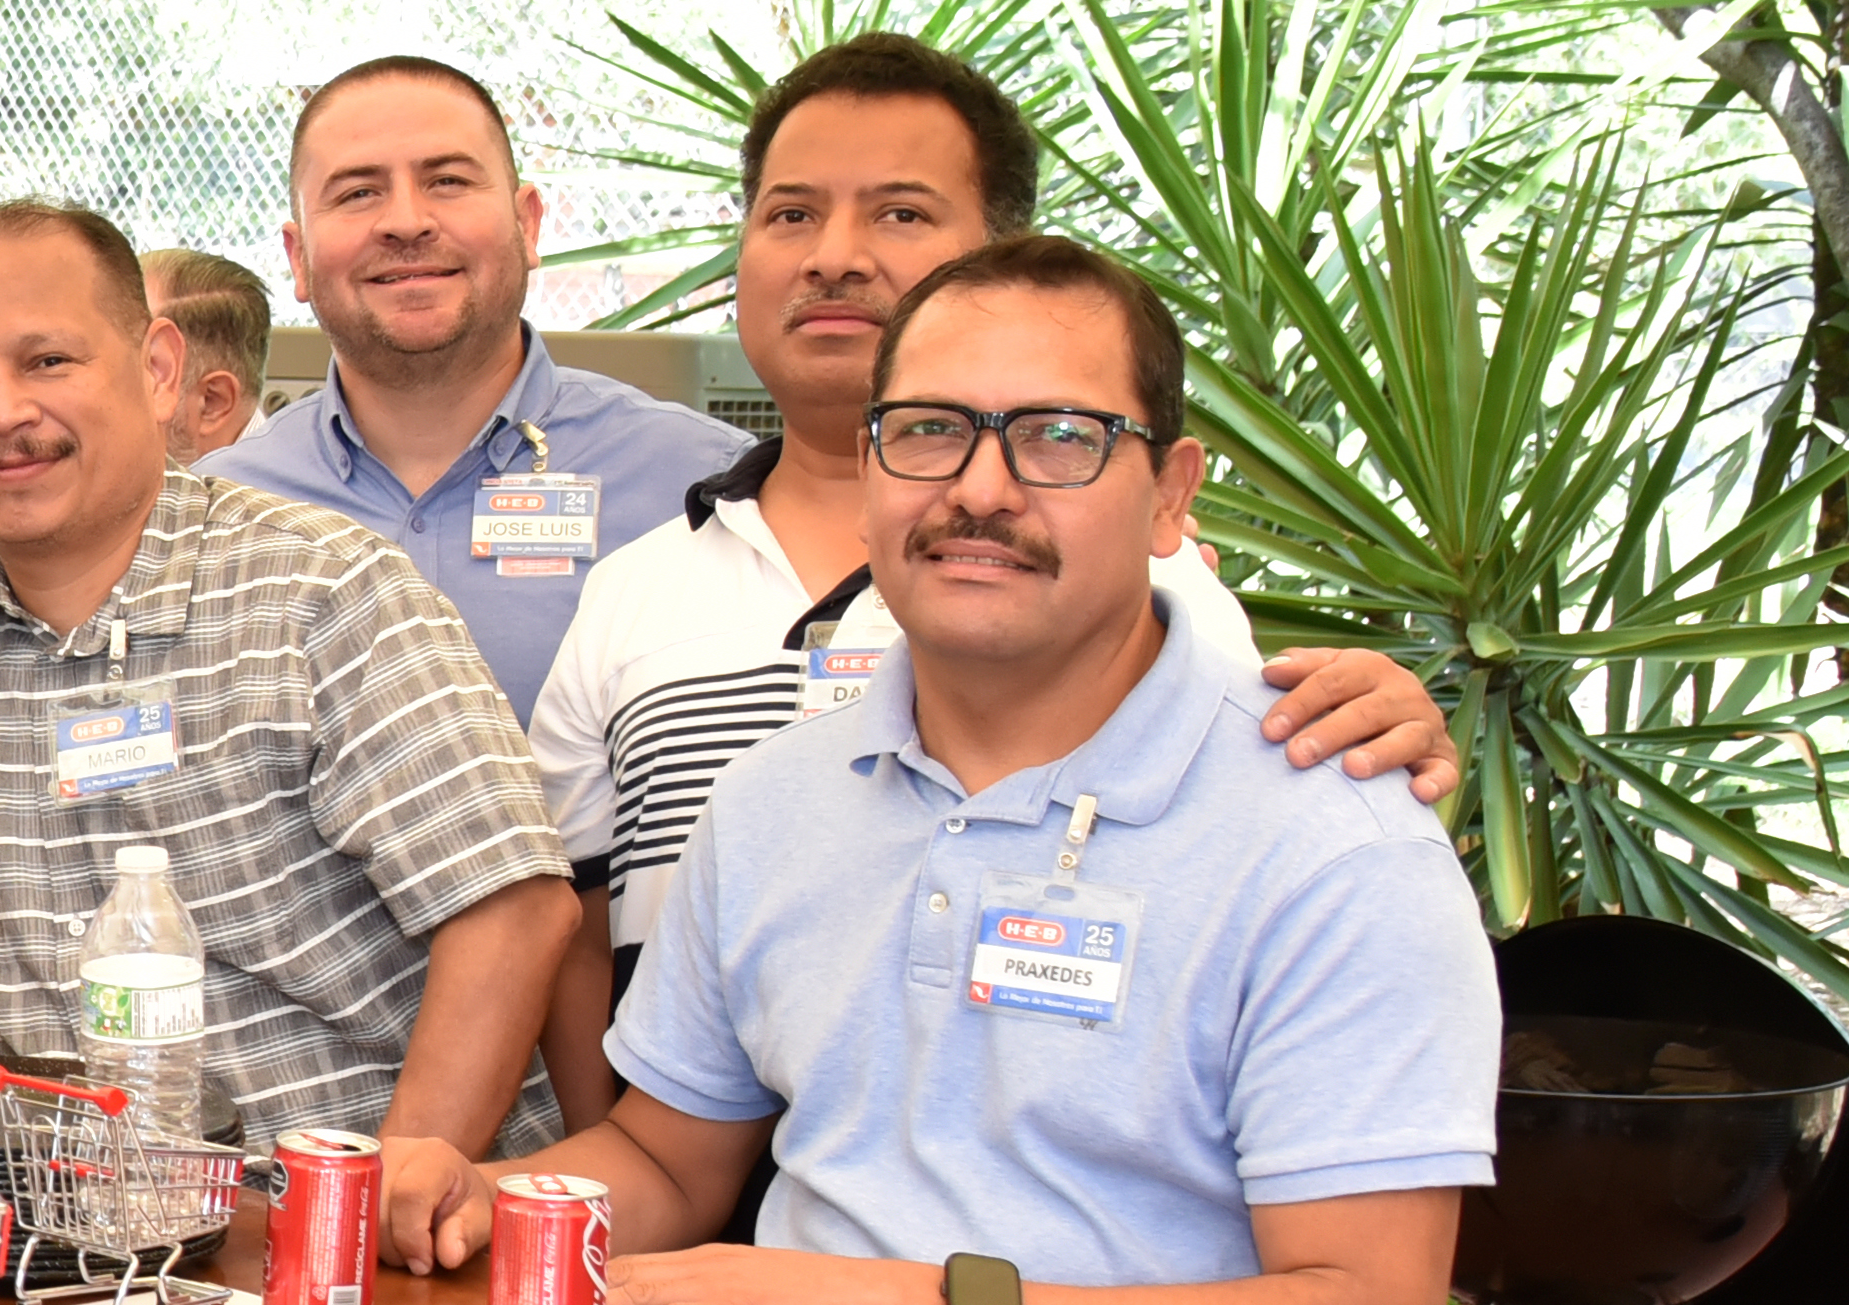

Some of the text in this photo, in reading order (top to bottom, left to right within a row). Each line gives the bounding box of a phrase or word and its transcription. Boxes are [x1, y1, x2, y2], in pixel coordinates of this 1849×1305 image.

[565, 493, 586, 505] 24
[483, 522, 582, 536] JOSE LUIS
[833, 686, 869, 702] DA
[139, 708, 160, 722] 25
[88, 745, 146, 769] MARIO
[1006, 922, 1114, 946] H-E-B 25
[1083, 945, 1111, 958] AÑOS
[1004, 958, 1093, 987] PRAXEDES
